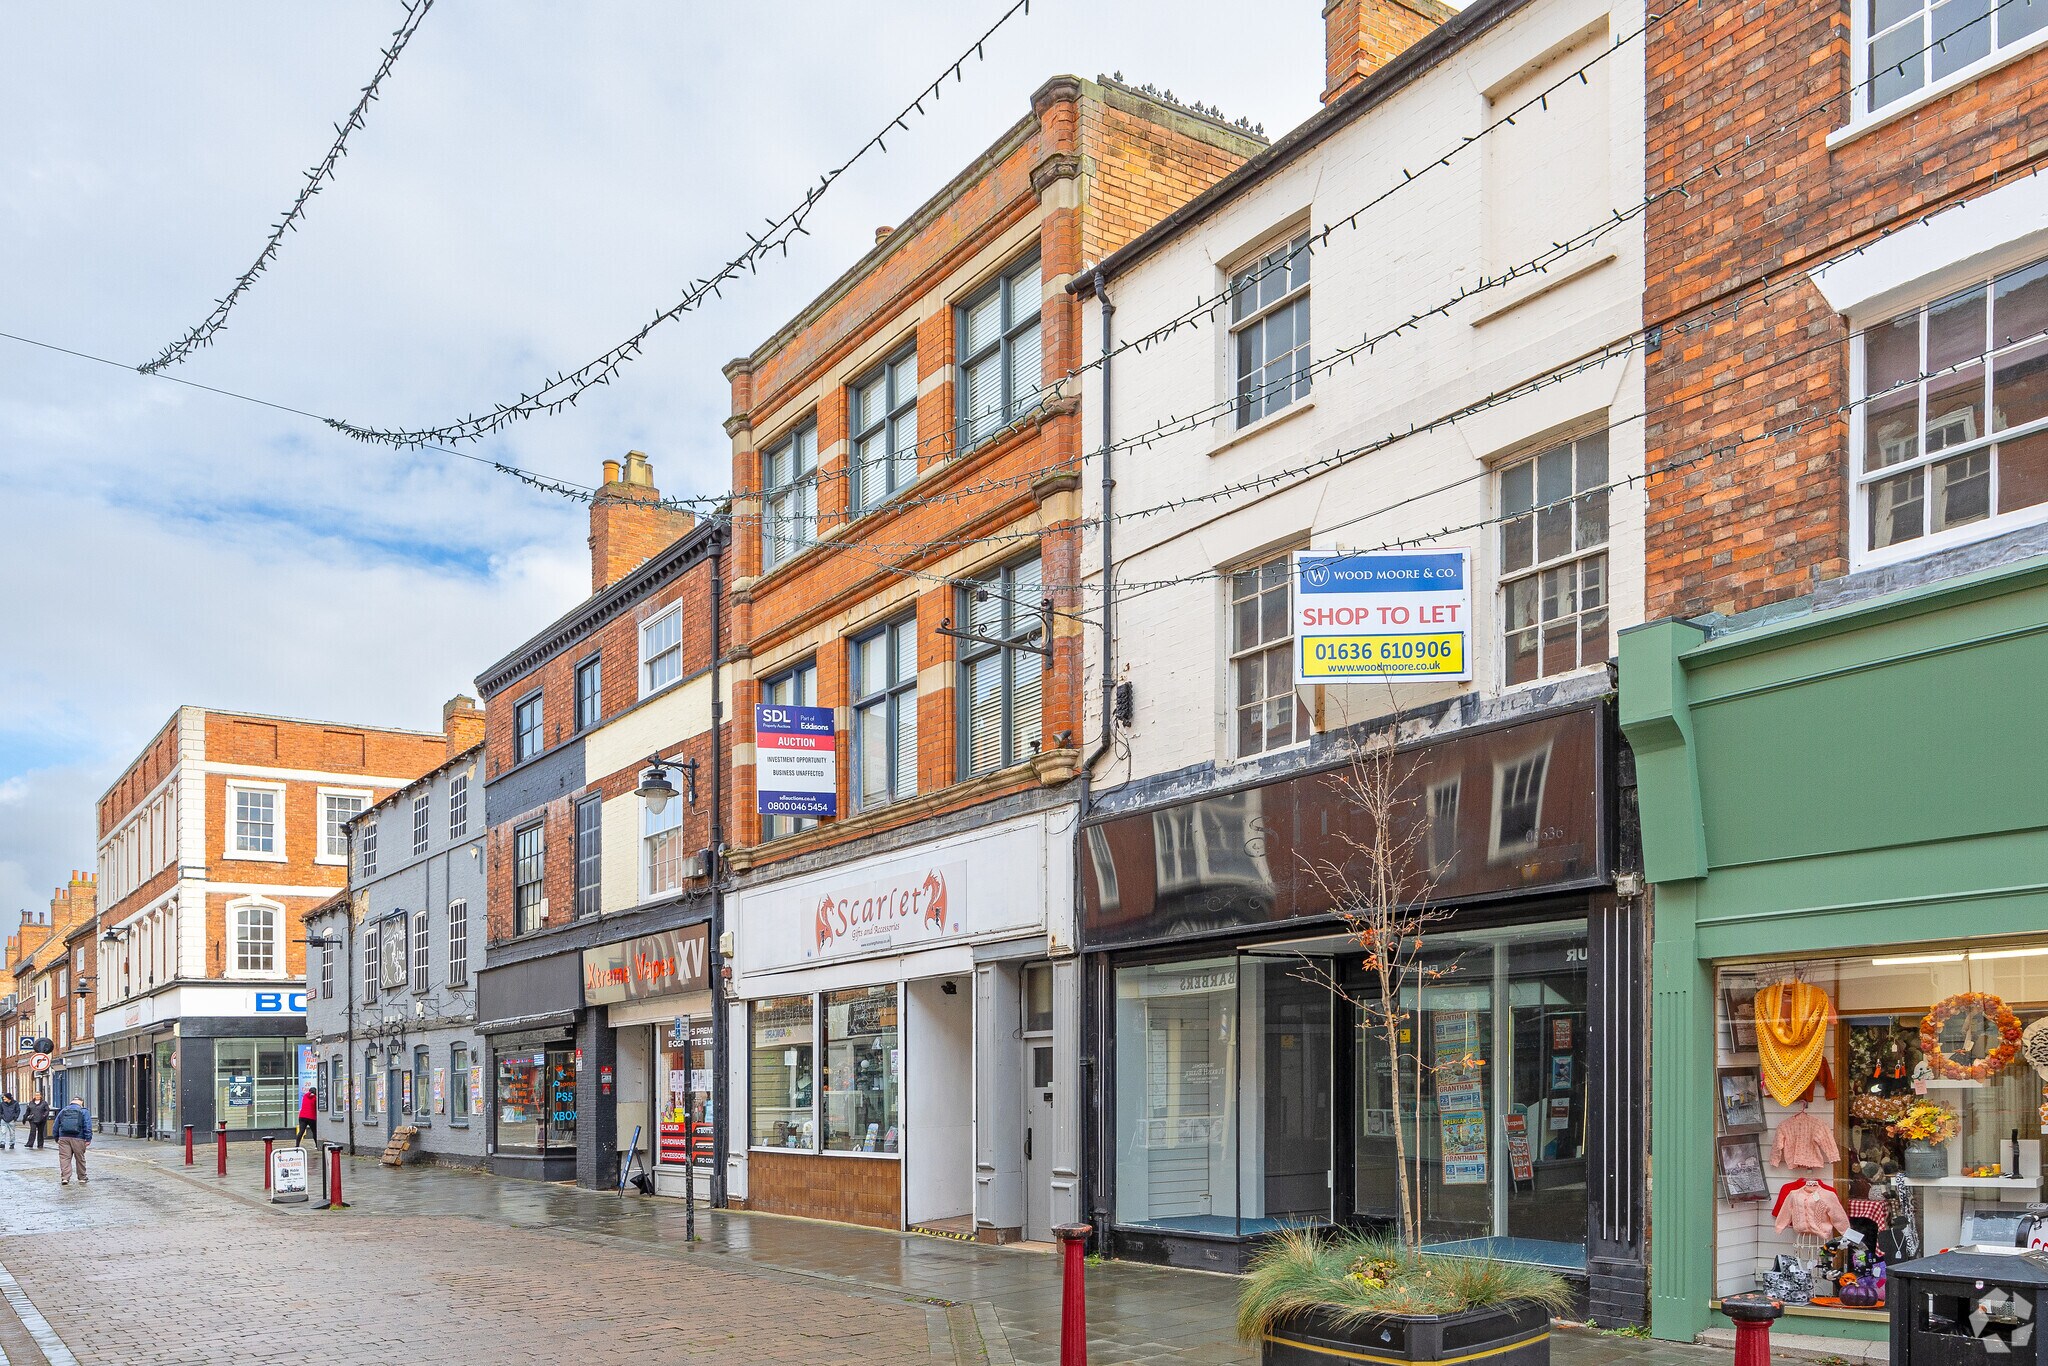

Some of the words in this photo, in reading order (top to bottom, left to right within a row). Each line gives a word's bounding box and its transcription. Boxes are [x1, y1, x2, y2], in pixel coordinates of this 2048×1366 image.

[1334, 571, 1372, 580] WOOD
[1376, 569, 1420, 579] MOORE
[1423, 568, 1433, 578] &
[1436, 568, 1457, 578] CO.
[1303, 607, 1369, 626] SHOP
[1376, 606, 1410, 625] TO
[1419, 604, 1461, 624] LET
[1315, 642, 1372, 660] 01636
[1380, 640, 1451, 659] 610906
[1327, 660, 1441, 673] www.woodmoore.co.uk
[762, 709, 791, 723] SDL
[800, 722, 829, 731] Eddisons
[778, 737, 815, 747] AUCTION
[768, 802, 790, 810] 0800
[791, 802, 807, 811] 046
[807, 803, 828, 811] 5454
[835, 887, 922, 938] Scarlet
[851, 927, 863, 941] Gifts
[864, 923, 874, 936] and
[874, 923, 900, 935] Accessories
[587, 962, 630, 990] Xtreme
[634, 952, 675, 985] Vapes
[677, 937, 705, 980] XV
[1440, 1084, 1474, 1093] GRANTHAM
[555, 1092, 573, 1102] PS5
[553, 1111, 577, 1121] XBOX
